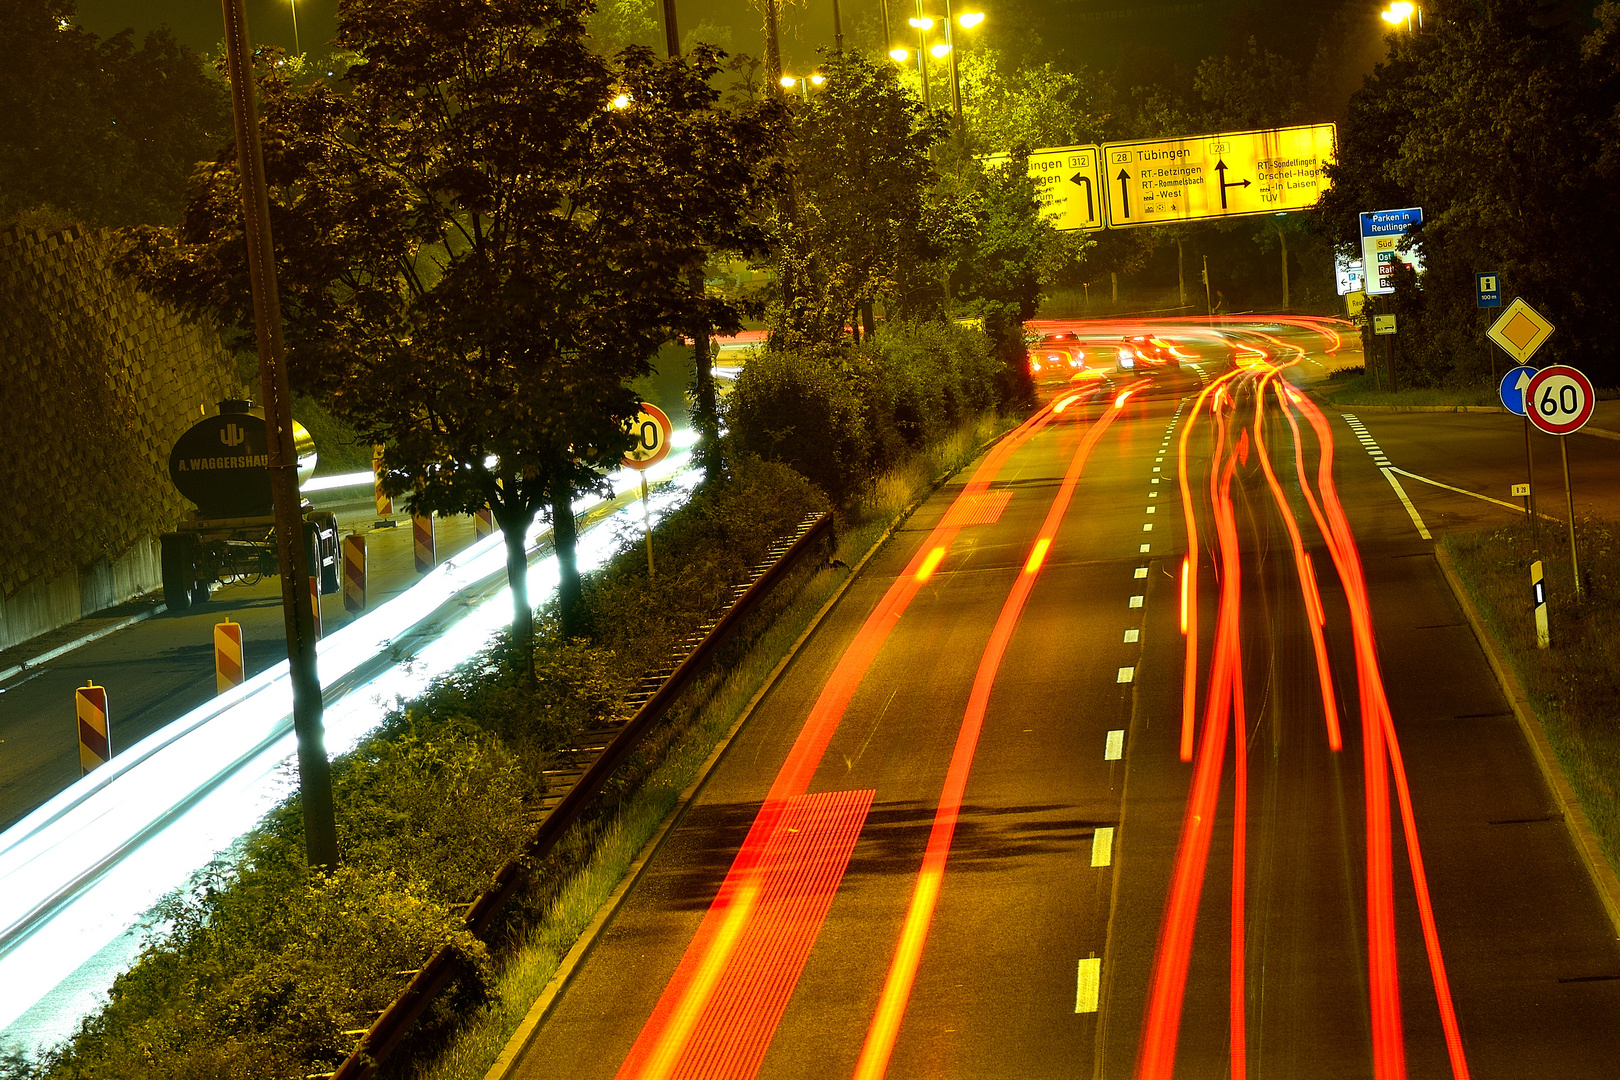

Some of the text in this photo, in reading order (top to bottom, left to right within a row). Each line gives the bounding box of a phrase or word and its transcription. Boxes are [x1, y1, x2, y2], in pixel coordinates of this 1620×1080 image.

[1116, 149, 1190, 162] 28 Tübingen
[1030, 160, 1062, 172] ingen
[1072, 158, 1086, 166] 312
[1141, 167, 1202, 178] RT.-Betzingen
[1287, 180, 1316, 189] Laisen
[1261, 193, 1278, 202] TÜV
[1372, 214, 1400, 222] Parken
[1540, 385, 1578, 416] 60
